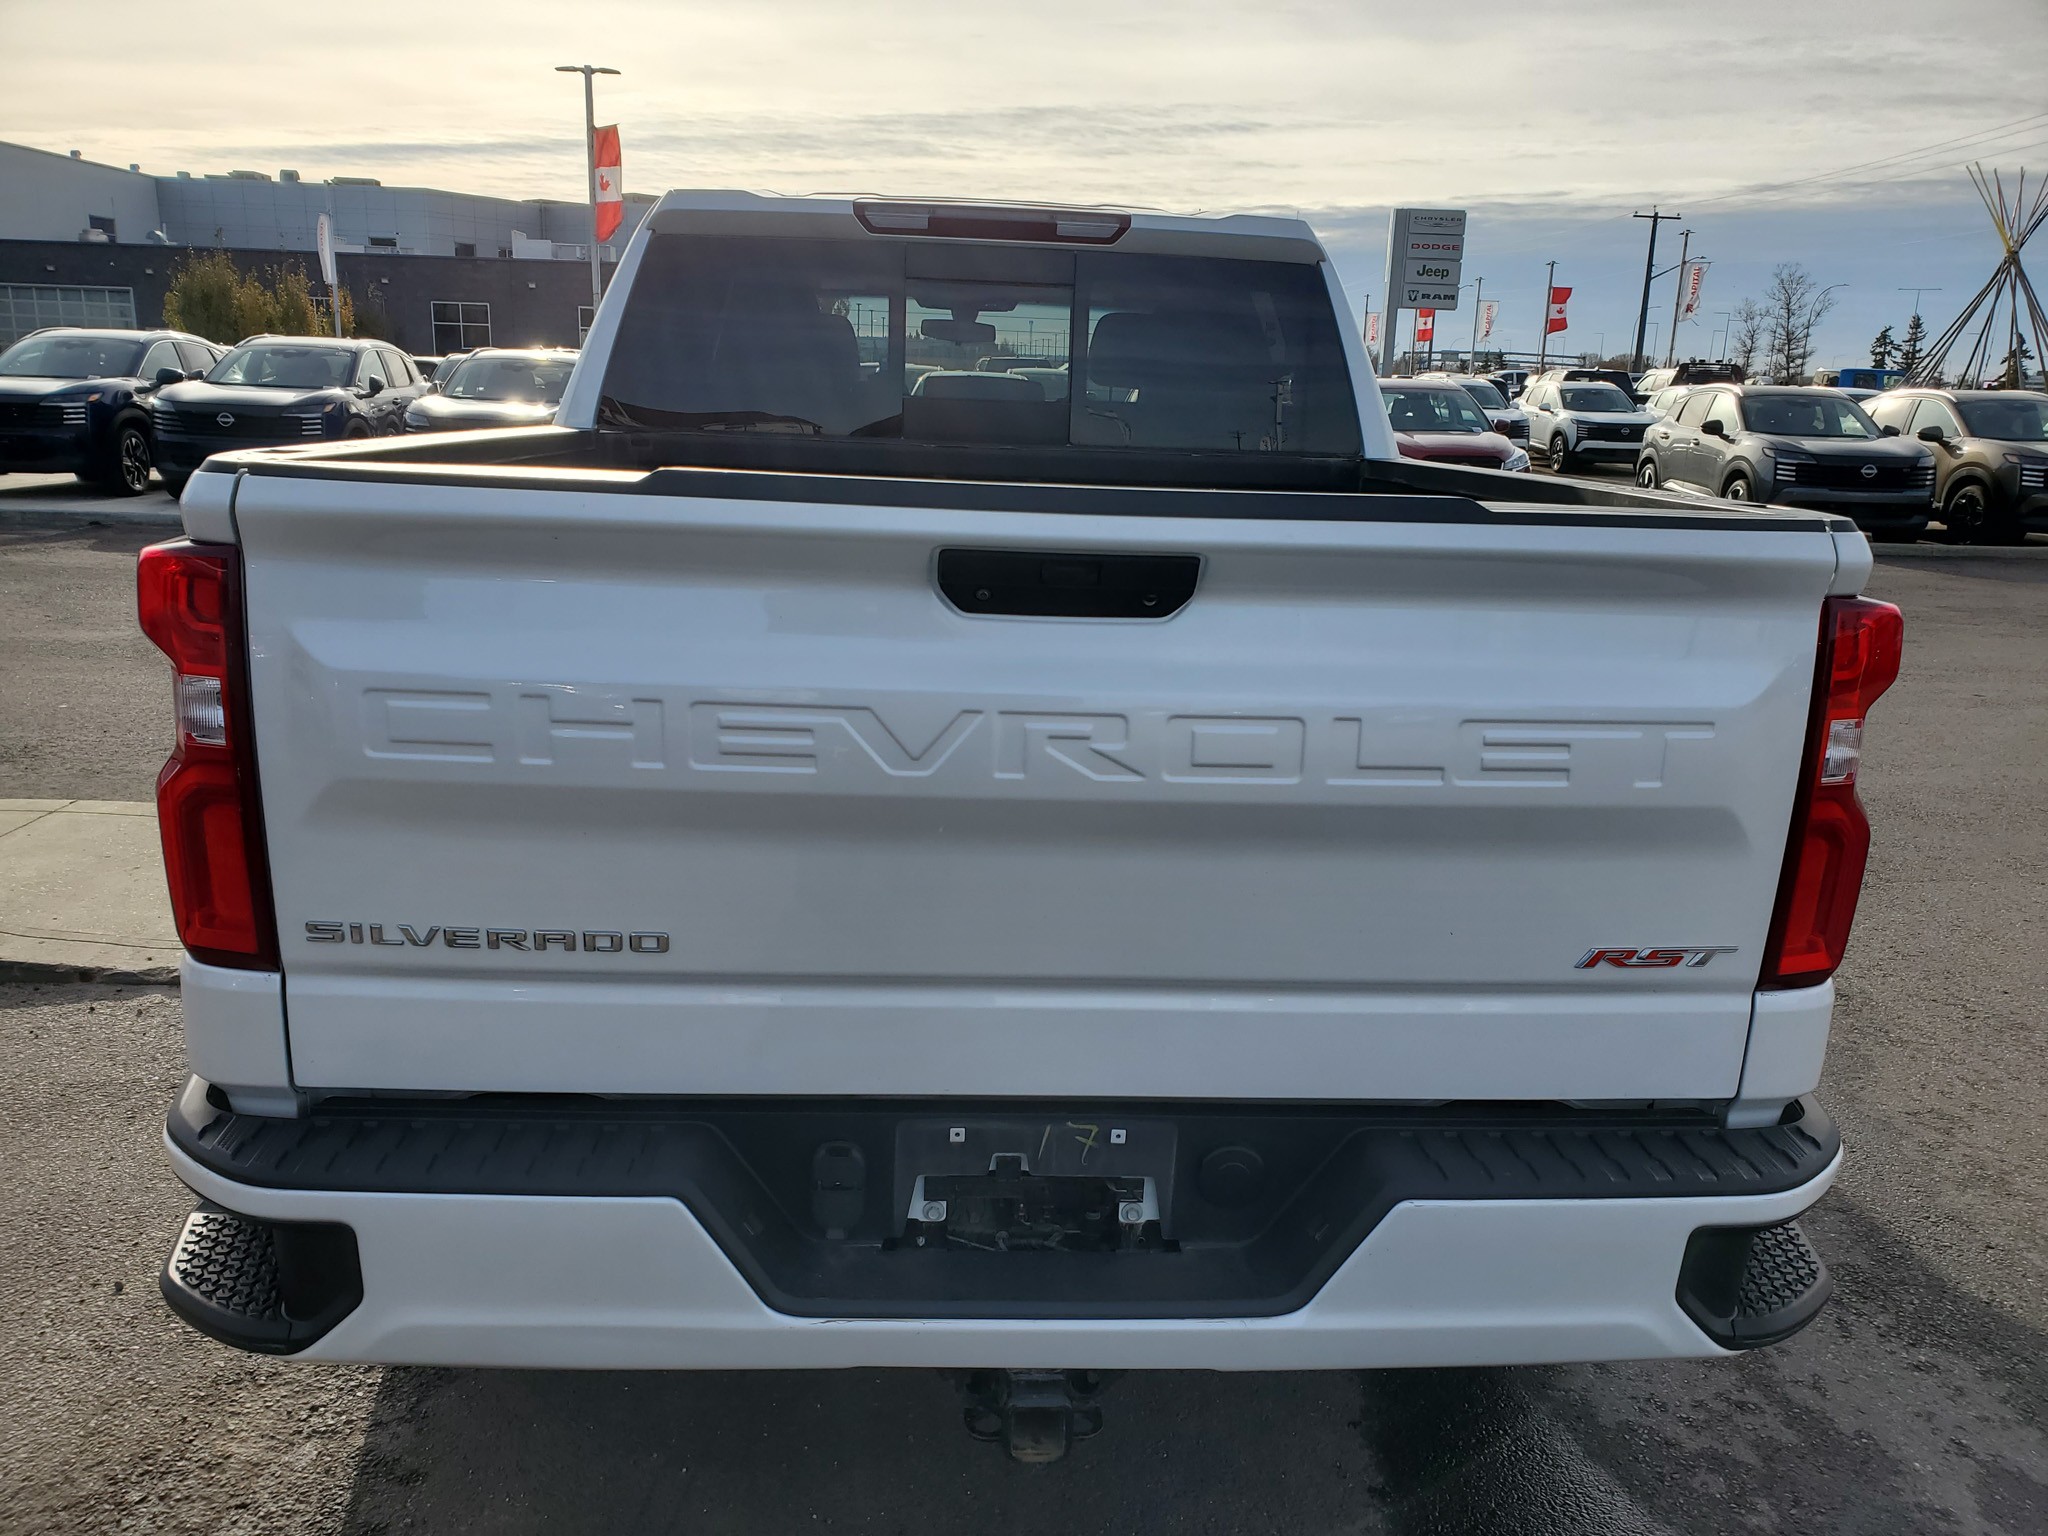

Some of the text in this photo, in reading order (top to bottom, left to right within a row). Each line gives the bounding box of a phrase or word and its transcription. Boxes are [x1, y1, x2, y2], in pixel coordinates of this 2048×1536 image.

[1411, 243, 1460, 251] DODGE
[1416, 264, 1449, 279] Jeep
[1421, 293, 1456, 301] RAM
[362, 687, 1716, 789] CHEVROLET
[304, 920, 671, 955] SILVERADO
[1573, 945, 1739, 969] RST
